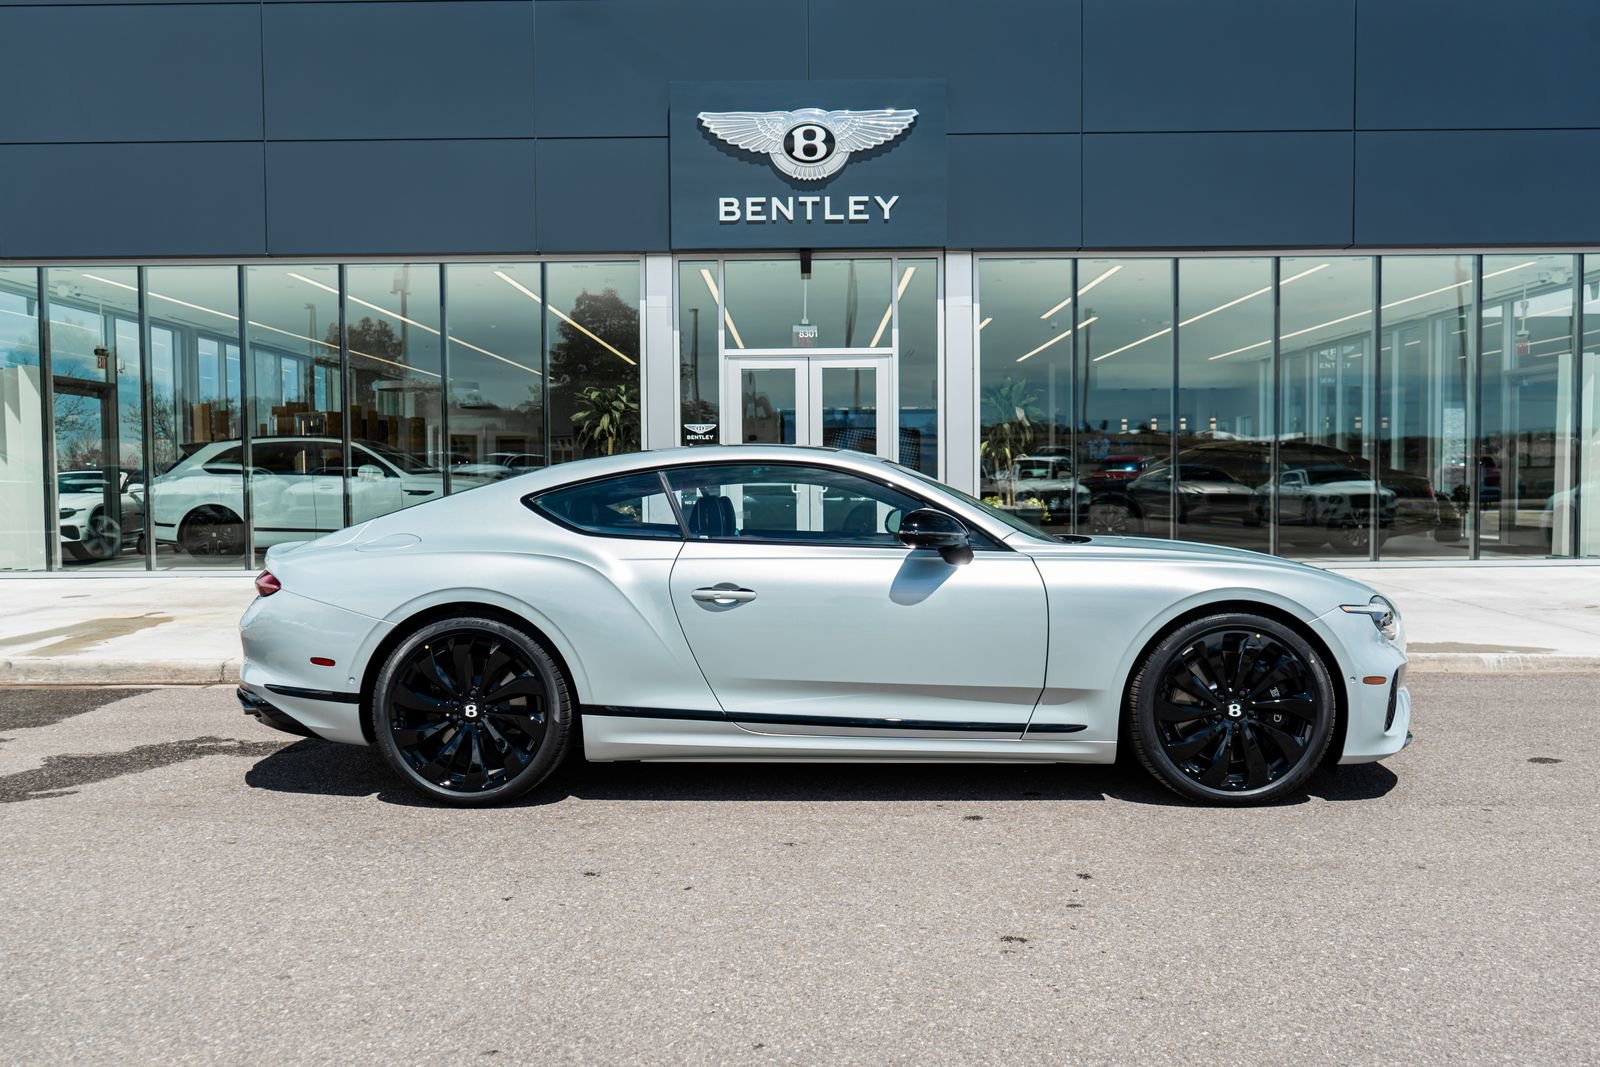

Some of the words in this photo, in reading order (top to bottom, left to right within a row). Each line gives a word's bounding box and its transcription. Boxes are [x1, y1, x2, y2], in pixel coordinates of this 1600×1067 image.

[791, 125, 827, 161] B
[719, 195, 899, 221] BENTLEY
[799, 329, 818, 338] 8301
[465, 704, 478, 718] B
[1228, 703, 1242, 717] B
